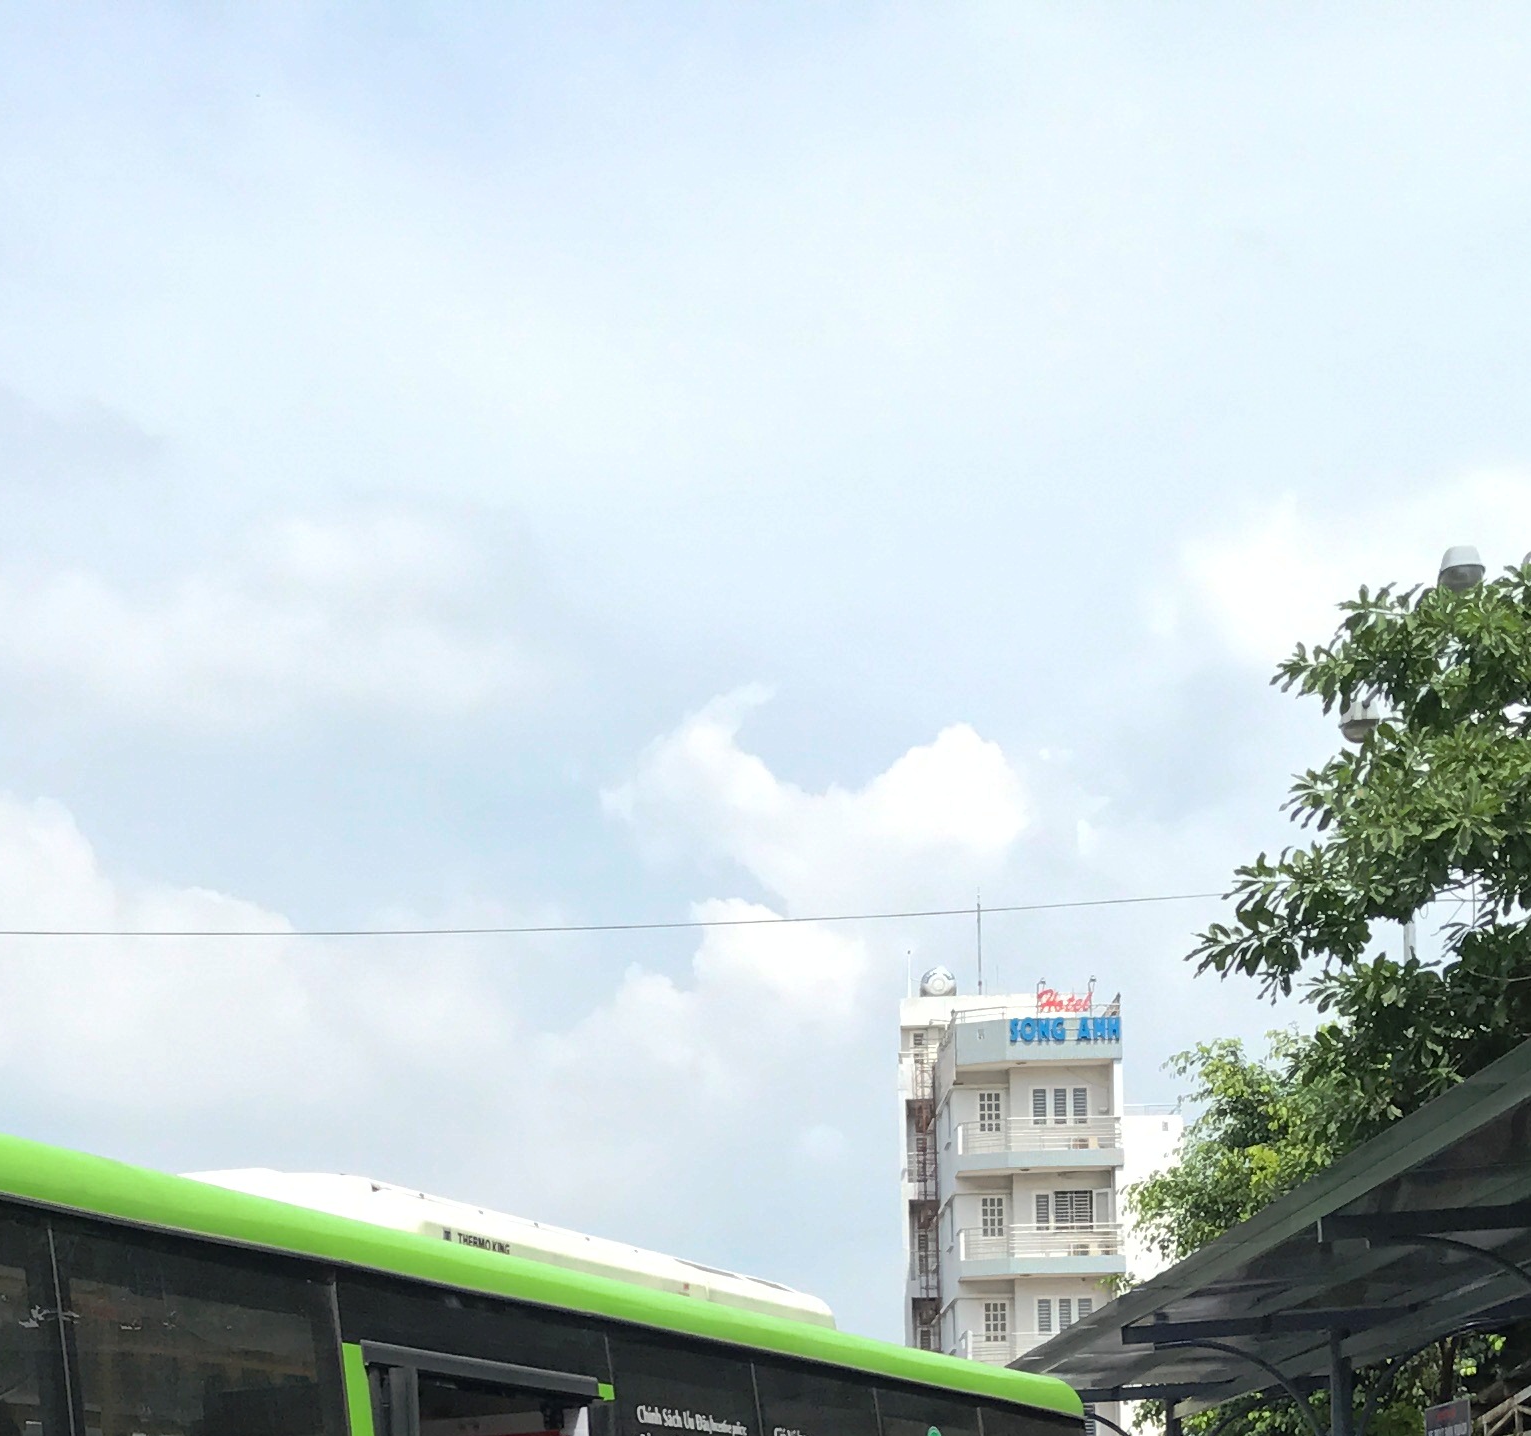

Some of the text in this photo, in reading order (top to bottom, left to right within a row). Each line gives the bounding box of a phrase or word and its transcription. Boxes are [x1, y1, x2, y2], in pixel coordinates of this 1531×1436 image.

[1037, 988, 1093, 1013] Hotel
[1010, 1017, 1121, 1042] SONG ANH
[457, 1232, 511, 1256] THERMO KING
